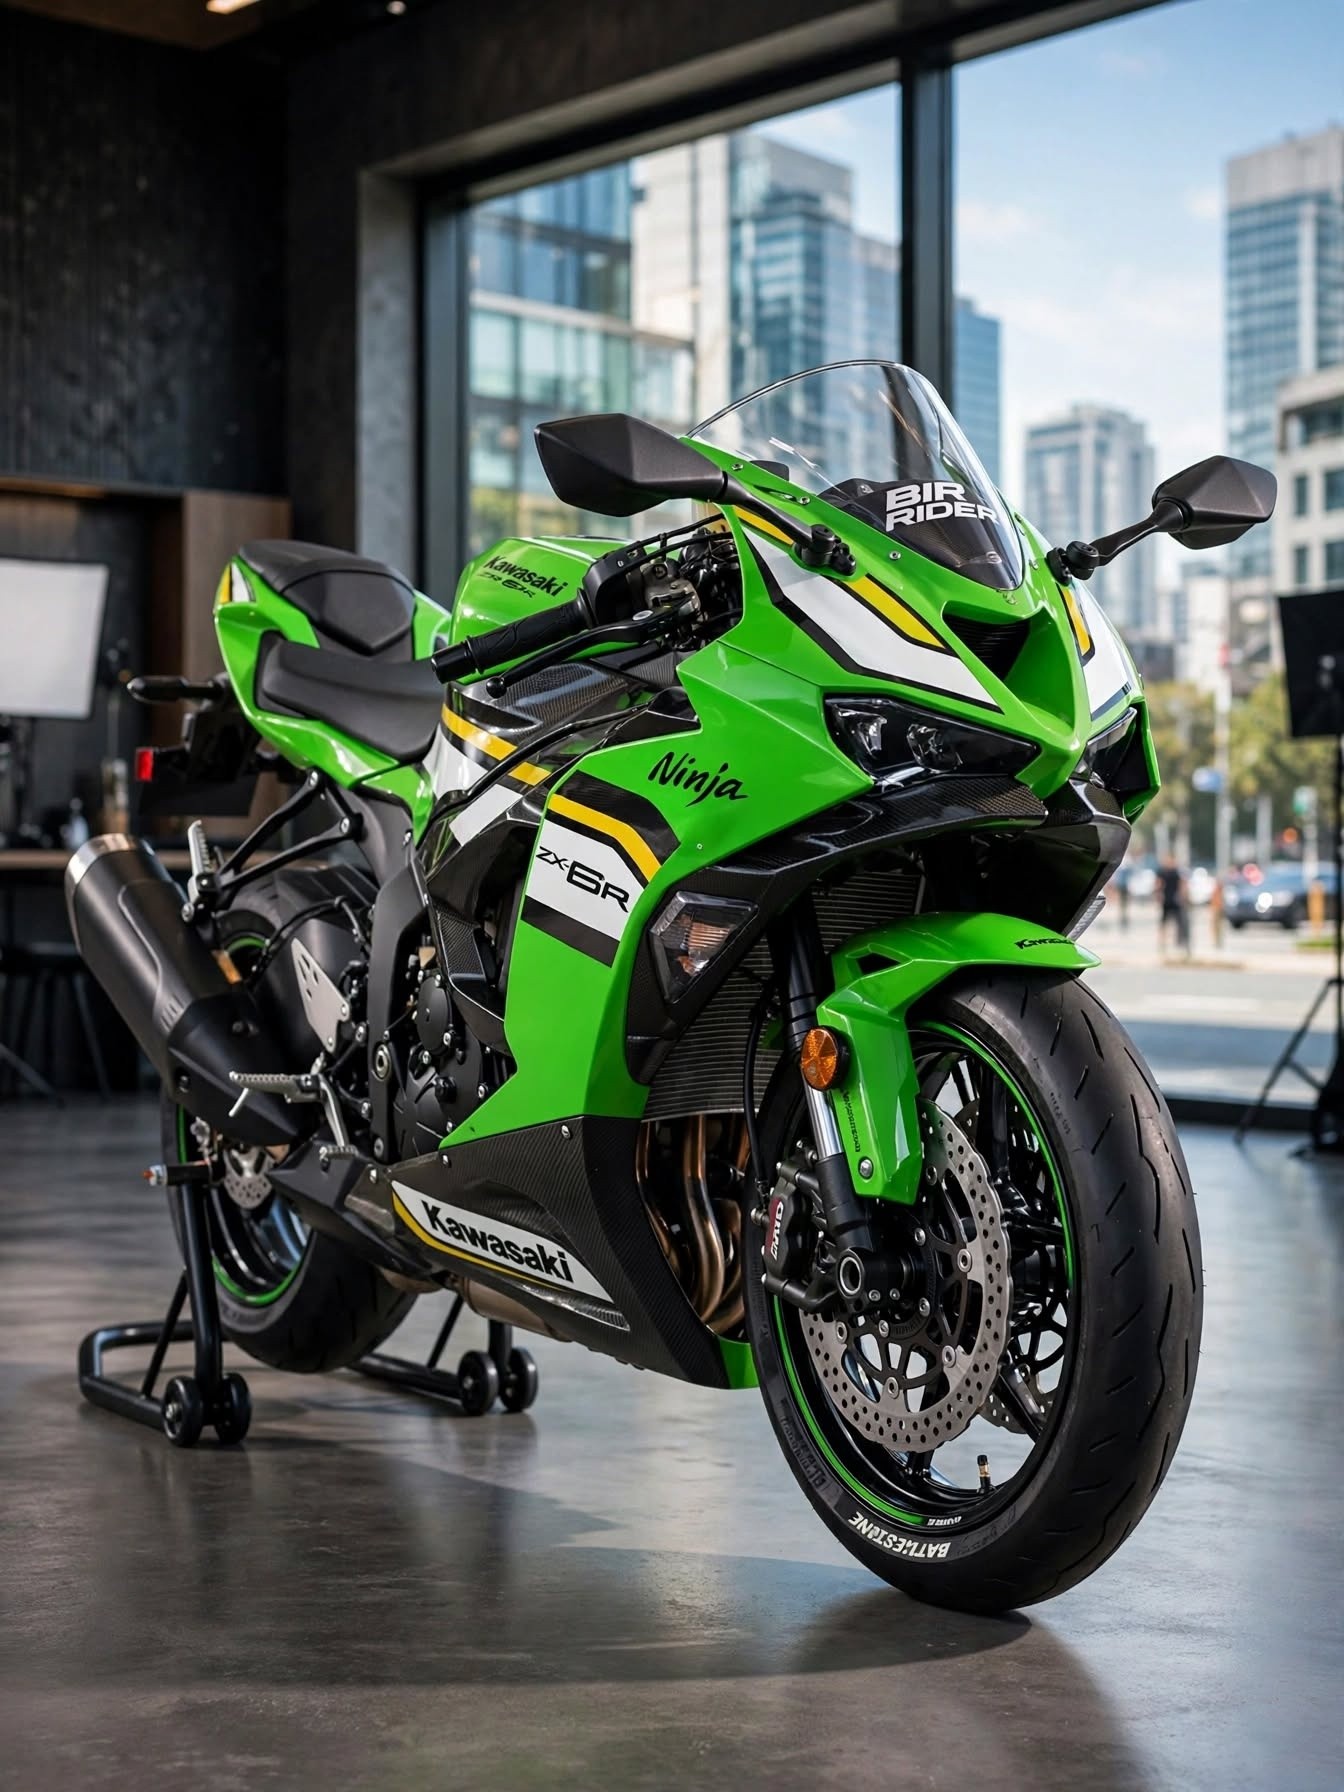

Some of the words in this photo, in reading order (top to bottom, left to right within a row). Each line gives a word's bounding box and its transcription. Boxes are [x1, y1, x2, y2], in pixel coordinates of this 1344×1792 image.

[885, 501, 999, 532] RIDER
[886, 482, 967, 512] BIR
[483, 555, 568, 597] Kawasaki
[647, 751, 749, 807] Ninja
[536, 845, 630, 913] ZX-6R
[421, 1199, 574, 1283] Kawasaki
